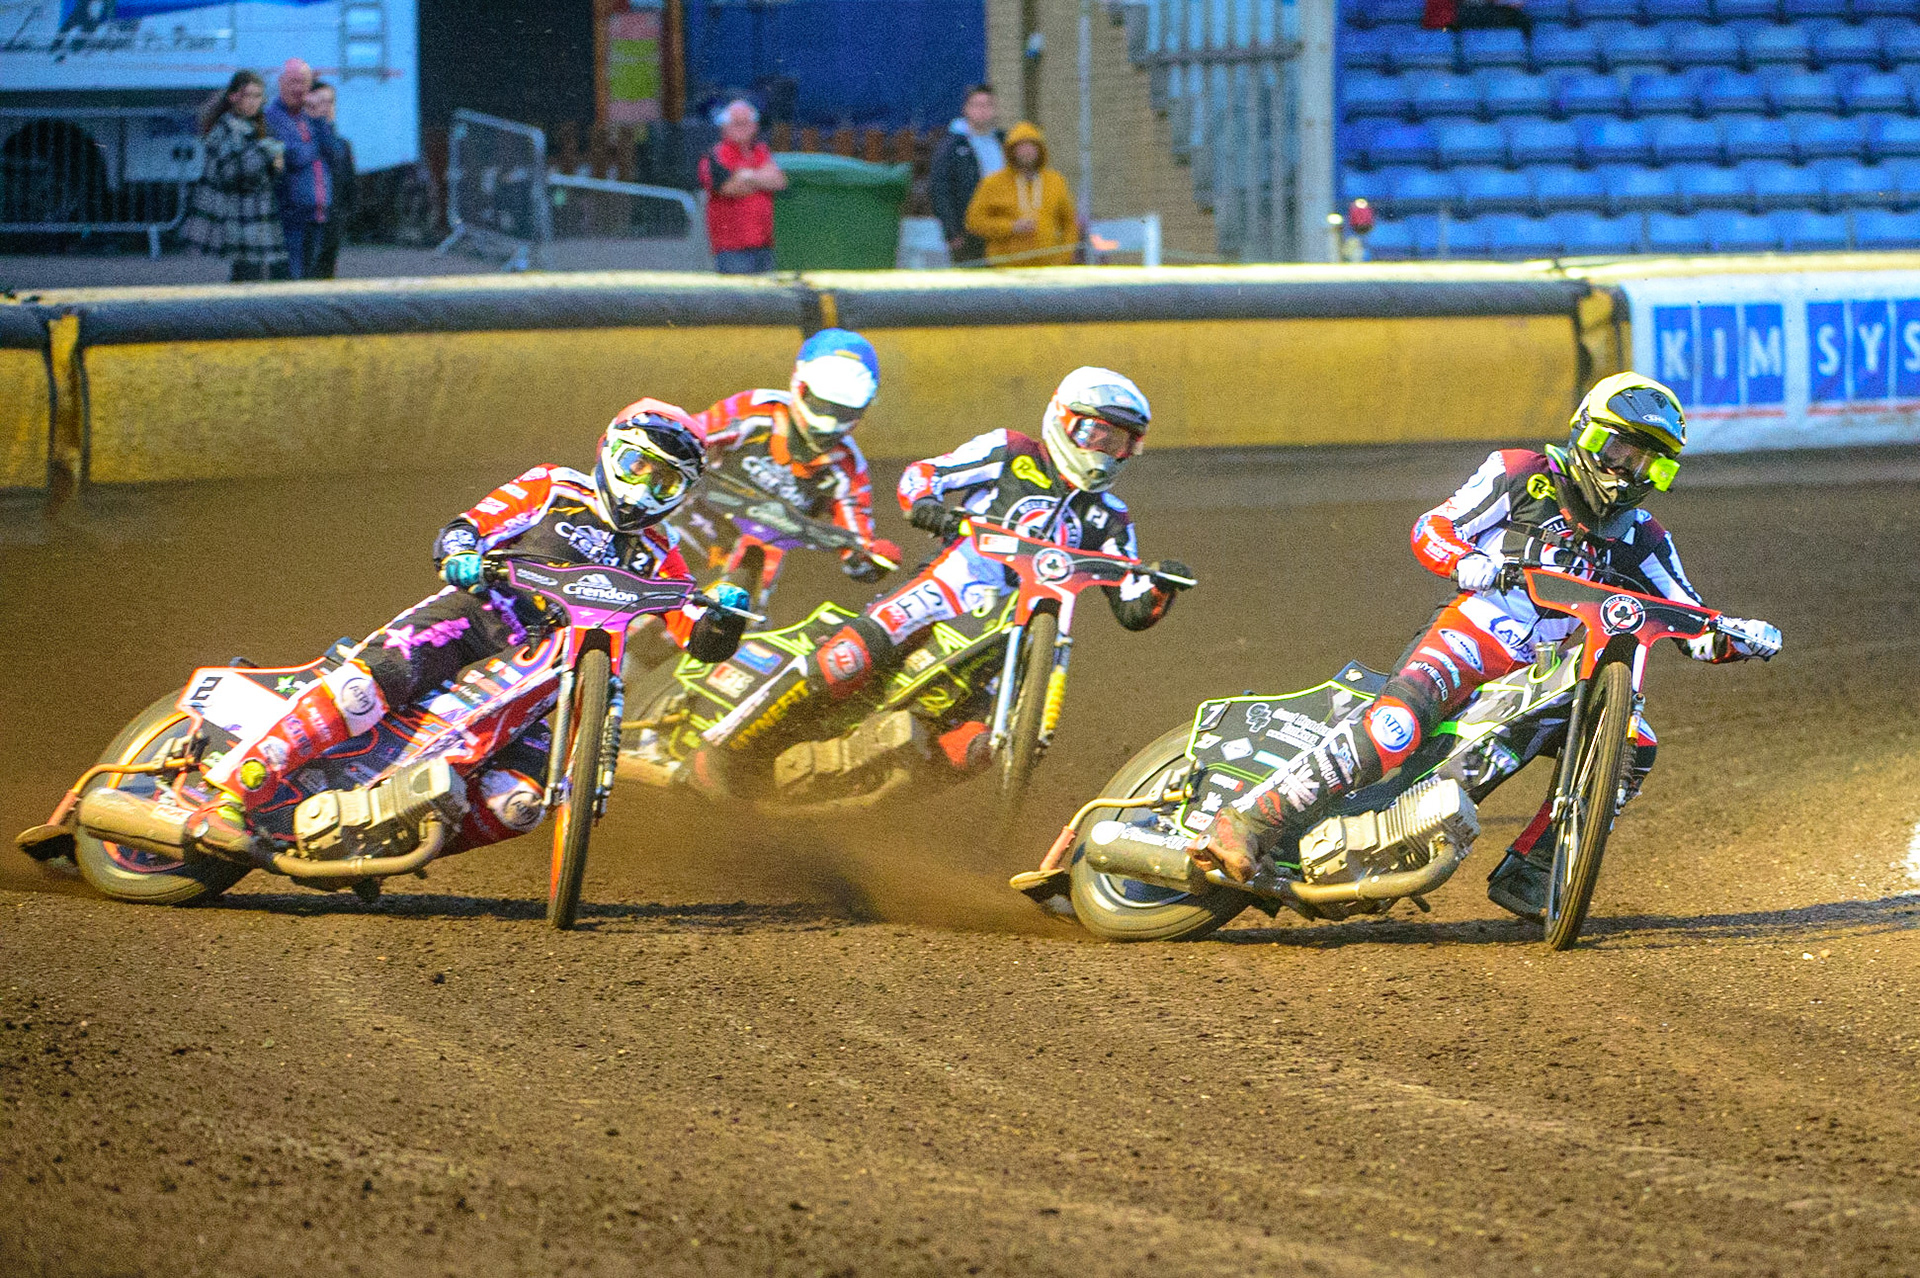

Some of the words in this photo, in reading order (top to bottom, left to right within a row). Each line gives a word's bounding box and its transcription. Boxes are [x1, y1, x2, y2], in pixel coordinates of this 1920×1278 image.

[1660, 324, 1782, 381] KIM
[631, 552, 649, 571] 2
[562, 582, 639, 603] Crendon
[896, 583, 943, 619] FTS
[189, 676, 223, 701] 2
[1382, 713, 1406, 742] ATPI
